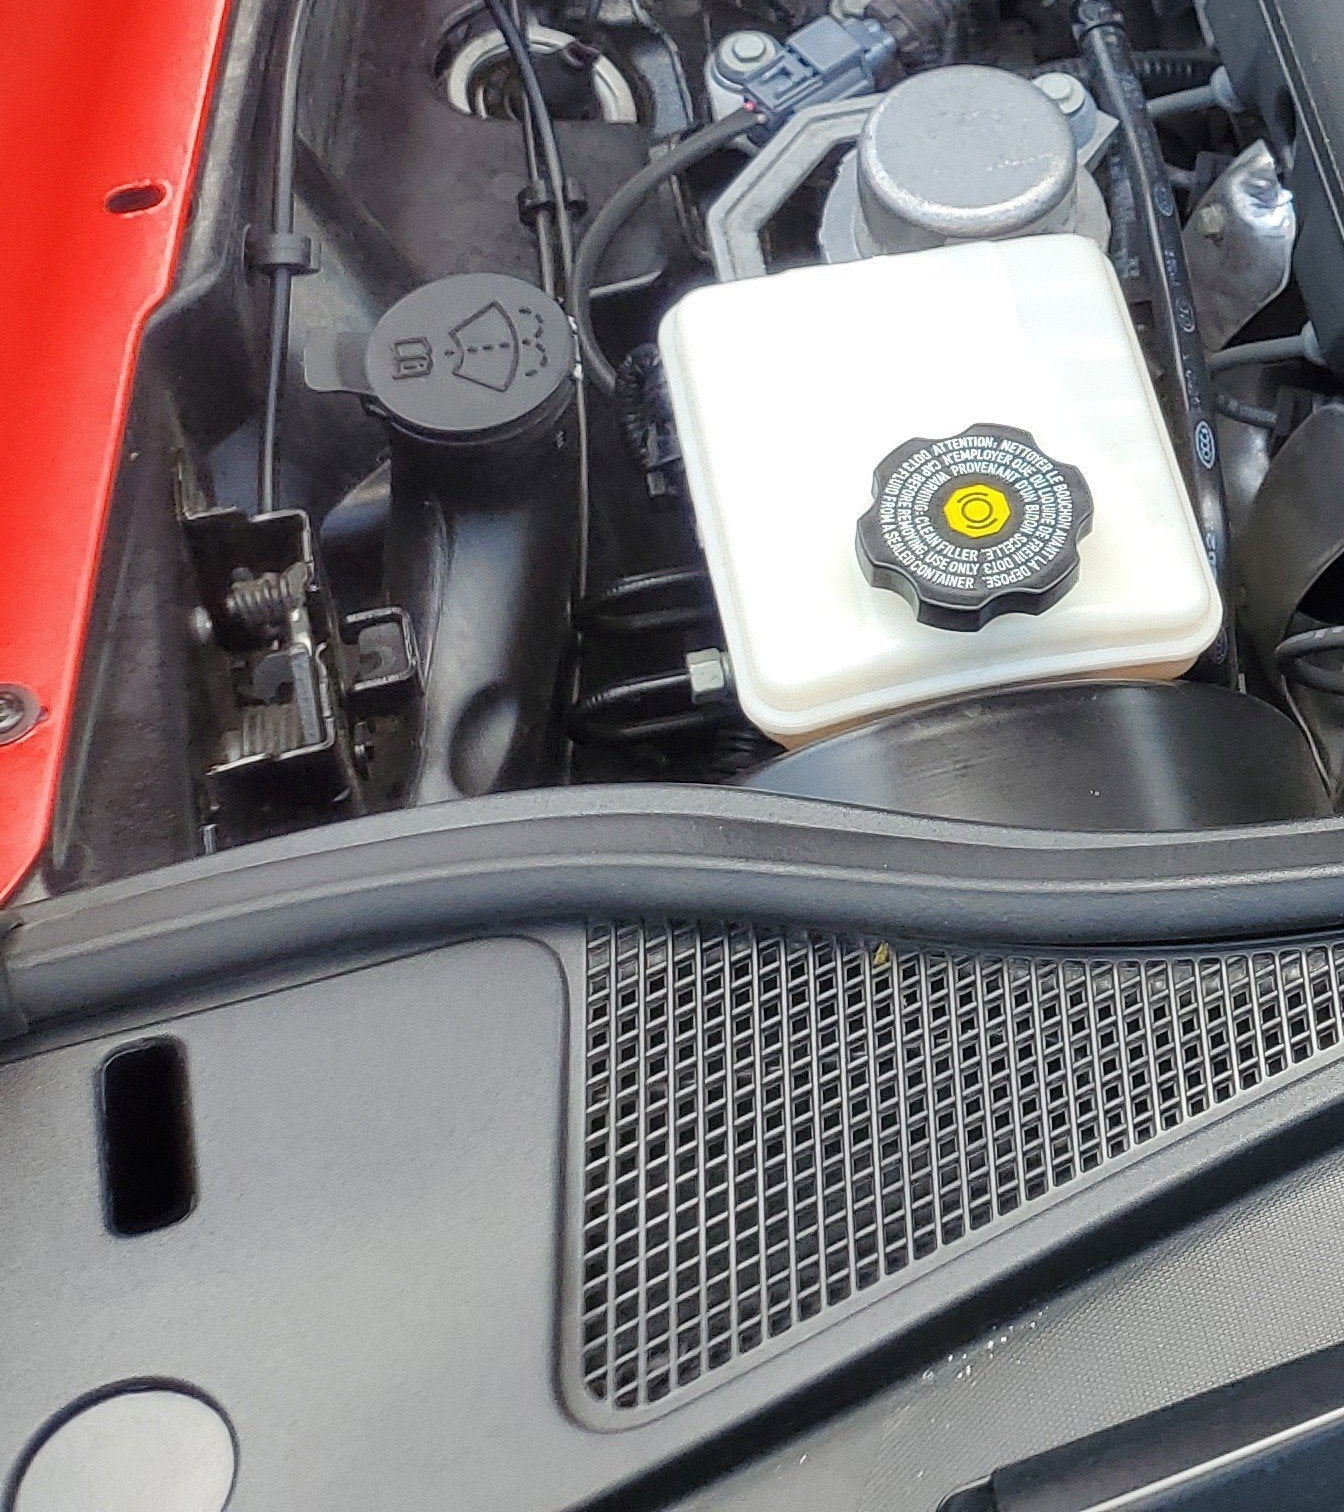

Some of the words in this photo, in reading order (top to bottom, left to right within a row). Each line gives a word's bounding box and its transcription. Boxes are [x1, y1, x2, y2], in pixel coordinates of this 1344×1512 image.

[932, 436, 998, 456] ATTENTION:
[941, 449, 1013, 466] N'EMPLOYER
[1001, 439, 1054, 473] NETTOYER
[901, 449, 932, 472] DOT3
[920, 459, 942, 477] CAP
[950, 461, 1021, 483] PROVENANT
[1011, 458, 1037, 477] QUE
[885, 468, 910, 496] FLUID
[1029, 474, 1049, 488] DU
[1046, 470, 1064, 484] LE
[898, 472, 926, 508] BEFORE
[914, 471, 951, 515] WARNING:
[1014, 479, 1038, 503] D'UN
[880, 495, 897, 523] FROM
[1038, 487, 1056, 525] LIQUIDE
[1053, 484, 1073, 529] BOUCHON
[881, 524, 897, 533] A
[1020, 504, 1039, 534] BIDON
[897, 509, 929, 558] REMOVING.
[914, 516, 943, 547] CLEAN
[1035, 525, 1053, 540] DE
[883, 530, 916, 566] SEALED
[936, 541, 979, 561] FILLER
[1012, 538, 1044, 565] FREIN
[1041, 529, 1067, 560] AVANT
[925, 551, 950, 570] USE
[948, 561, 979, 575] ONLY
[983, 557, 1015, 574] DOT3
[1027, 556, 1047, 571] LA
[910, 560, 975, 589] CONTAINER
